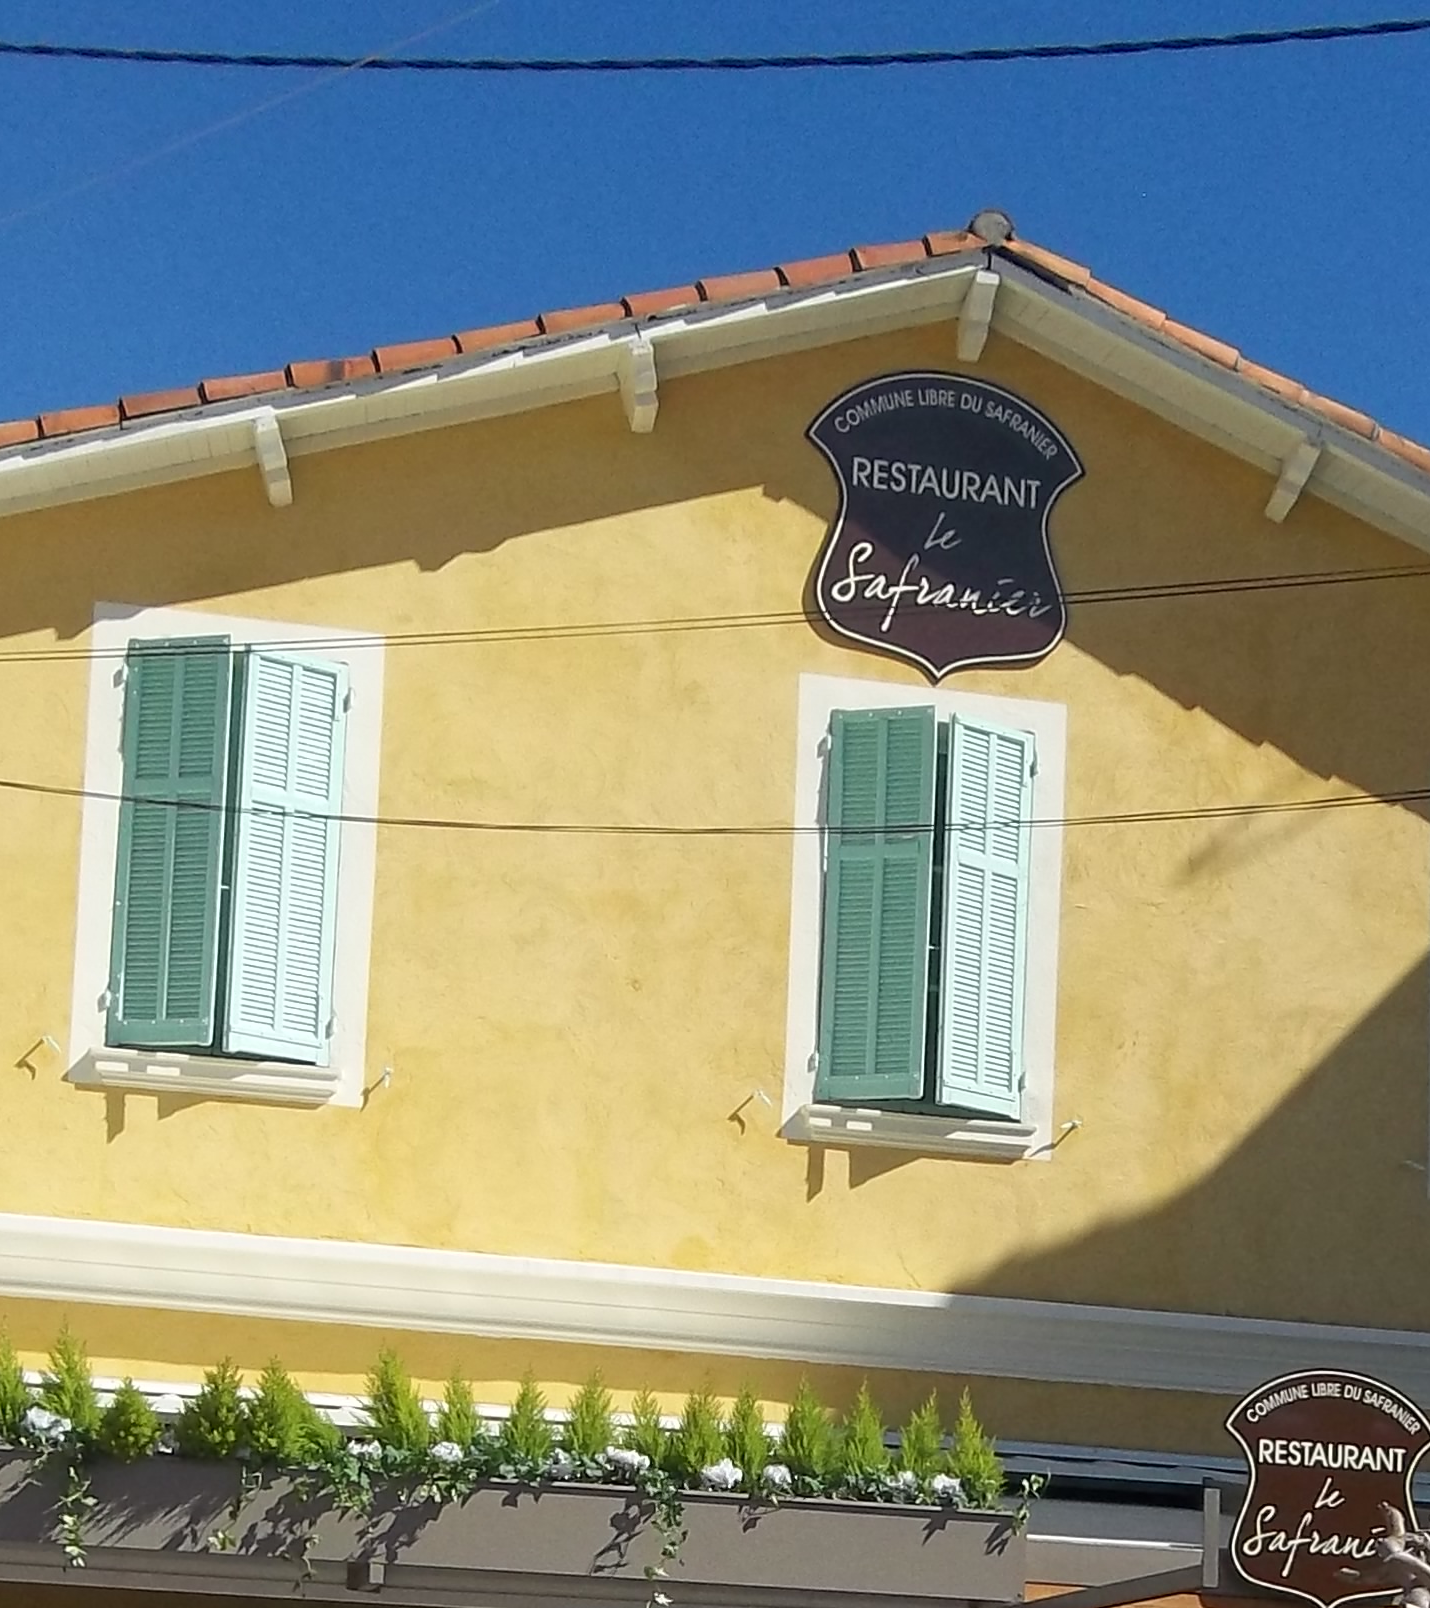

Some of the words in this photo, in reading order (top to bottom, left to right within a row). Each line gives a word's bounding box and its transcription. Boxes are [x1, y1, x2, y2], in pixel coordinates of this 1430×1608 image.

[834, 389, 914, 433] COMMUNE
[918, 388, 956, 408] LIBRE
[960, 393, 983, 414] DU
[984, 400, 1059, 461] SAFRANIER
[850, 455, 1042, 511] RESTAURANT
[1246, 1383, 1309, 1423] COMMUNE
[1311, 1382, 1342, 1397] LIBRE
[1343, 1384, 1362, 1401] DU
[1363, 1390, 1421, 1435] SAFRANIER
[1258, 1438, 1407, 1473] RESTAURANT
[1242, 1504, 1386, 1578] Safrani
